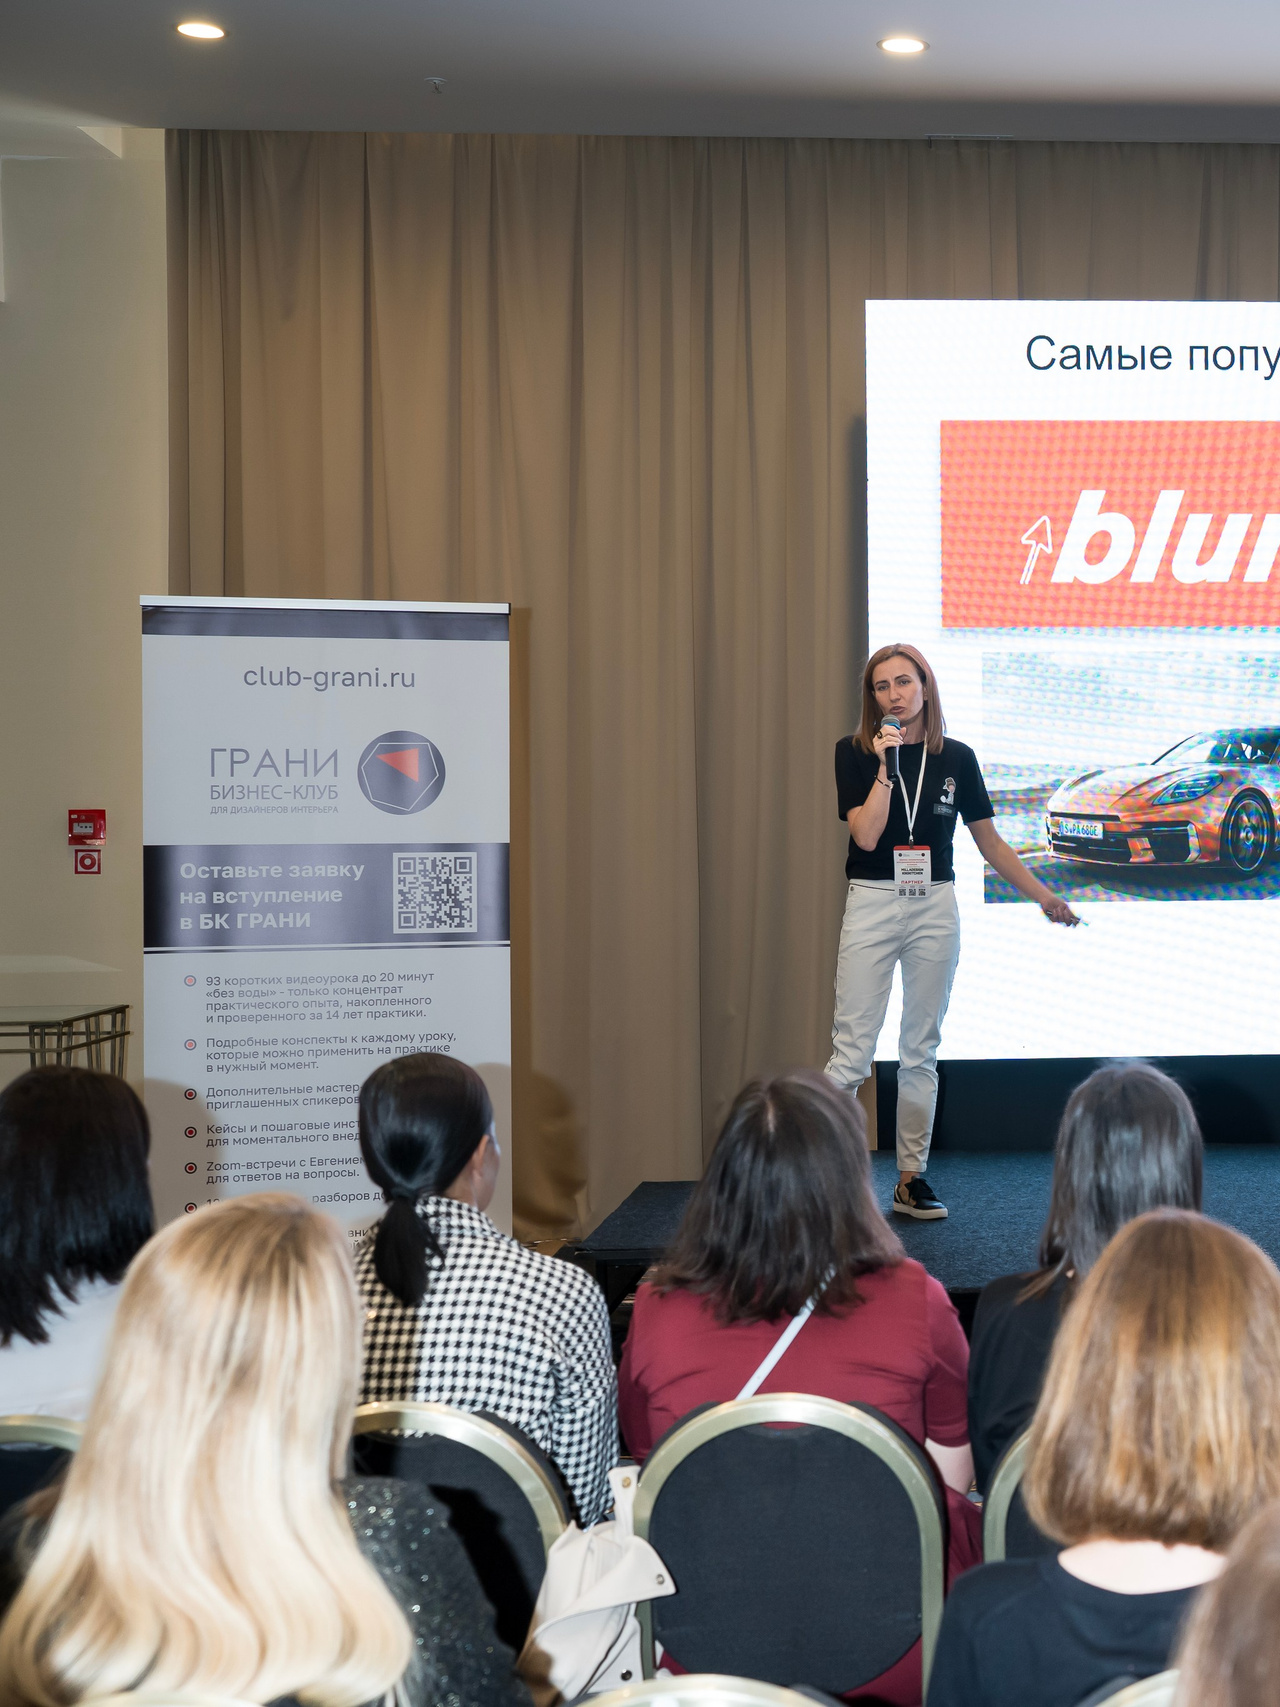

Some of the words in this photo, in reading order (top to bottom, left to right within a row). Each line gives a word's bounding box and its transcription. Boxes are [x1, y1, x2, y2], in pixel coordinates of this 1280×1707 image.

[1025, 334, 1173, 371] Самые
[243, 665, 416, 692] club-grani.ru
[210, 748, 338, 778] ГРАНИ
[210, 784, 339, 800] БИЗНЕС-КЛУБ
[210, 806, 228, 815] ДЛЯ
[230, 805, 289, 815] ДИЗАЙНЕРОВ
[291, 805, 339, 814] ИНТЕРЬЕРА
[180, 862, 283, 879] Оставьте
[288, 864, 365, 881] заявку
[180, 891, 207, 904] на
[212, 889, 344, 908] вступление
[180, 917, 193, 930] в
[199, 913, 230, 930] БК
[236, 912, 311, 929] ГРАНИ
[206, 976, 221, 987] 93
[224, 977, 283, 987] коротких
[286, 974, 359, 986] видеоурока
[361, 974, 377, 984] до
[379, 972, 395, 982] 20
[397, 972, 435, 983] минут
[206, 988, 235, 998] «без
[238, 988, 277, 999] воды»
[287, 987, 330, 997] только
[333, 985, 404, 996] концентрат
[206, 1000, 300, 1012] практического
[302, 999, 343, 1009] опыта,
[346, 997, 432, 1007] накопленного
[206, 1015, 214, 1023] и
[217, 1012, 306, 1024] проверенного
[309, 1011, 323, 1020] за
[326, 1010, 340, 1020] 14
[342, 1011, 363, 1020] лет
[366, 1008, 427, 1020] практики.
[206, 1037, 279, 1049] Подробные
[281, 1035, 348, 1046] конспекты
[351, 1035, 358, 1043] к
[361, 1033, 416, 1044] каждому
[418, 1032, 457, 1043] уроку,
[206, 1050, 260, 1061] которые
[262, 1048, 305, 1058] можно
[307, 1046, 374, 1058] применить
[377, 1046, 392, 1055] на
[394, 1043, 451, 1055] практике
[206, 1064, 214, 1073] в
[216, 1061, 267, 1074] нужный
[270, 1060, 319, 1071] момент.
[206, 1084, 313, 1098] Дополнительные
[206, 1098, 299, 1111] приглашенных
[302, 1096, 360, 1106] спикеров
[206, 1124, 247, 1134] Кейсы
[250, 1124, 258, 1132] и
[261, 1120, 330, 1132] пошаговые
[206, 1138, 229, 1148] для
[232, 1132, 329, 1146] моментального
[206, 1158, 296, 1172] Zoom-встречи
[299, 1159, 307, 1167] с
[206, 1174, 230, 1184] для
[232, 1171, 282, 1183] ответов
[285, 1170, 300, 1180] на
[303, 1168, 360, 1180] вопросы.
[312, 1192, 370, 1203] разборов
